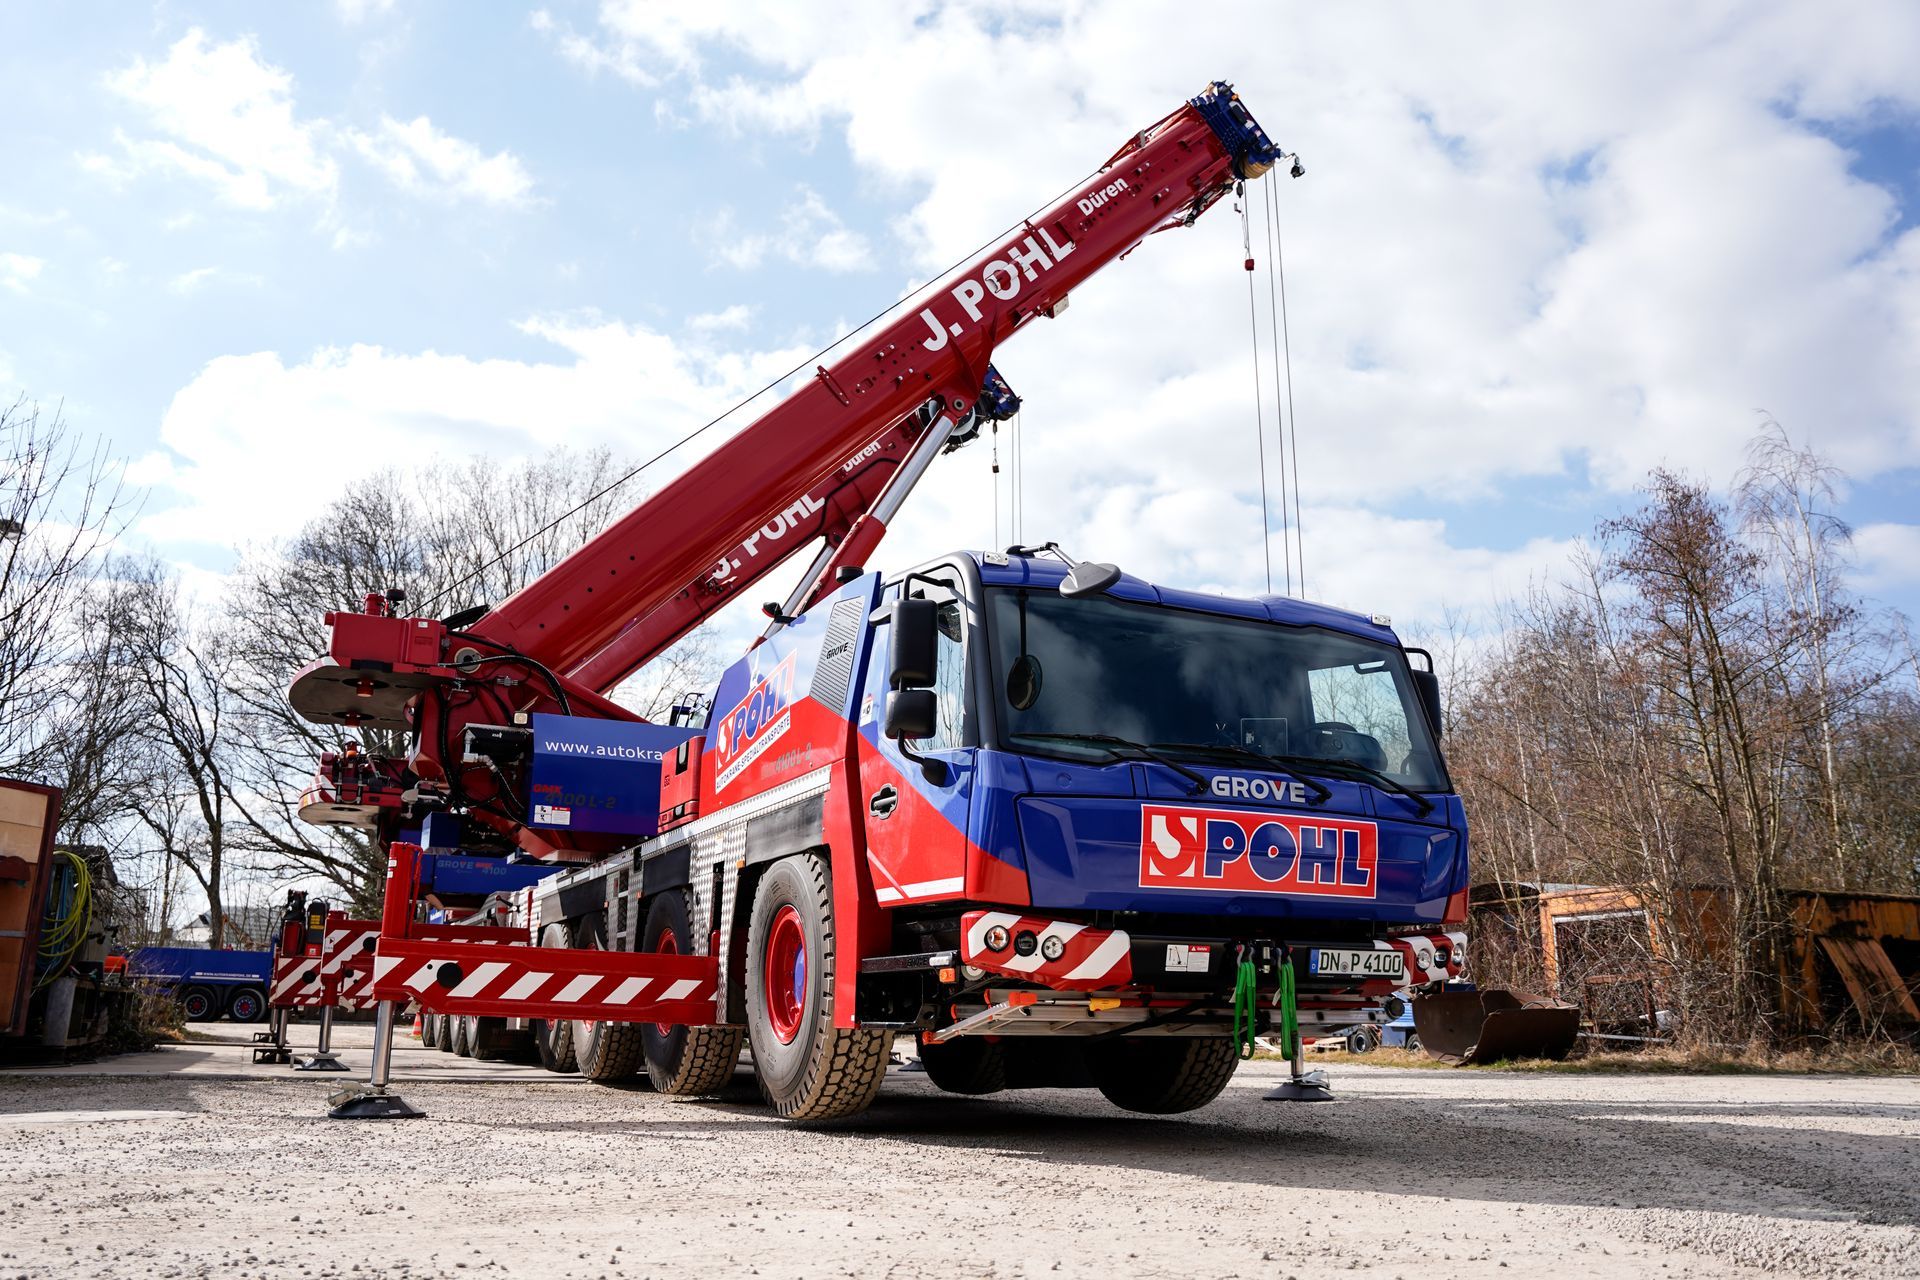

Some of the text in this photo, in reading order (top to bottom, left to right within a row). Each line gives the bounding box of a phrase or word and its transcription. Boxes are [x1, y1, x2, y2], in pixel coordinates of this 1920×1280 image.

[920, 177, 1128, 351] J. POHL Düren
[826, 642, 848, 659] GROVE
[732, 663, 790, 756] POHL
[545, 741, 662, 760] www.autokra
[1211, 775, 1306, 803] GROVE
[437, 860, 473, 869] GROVE
[1203, 818, 1371, 887] POHL
[1319, 952, 1402, 973] DN P 4100
